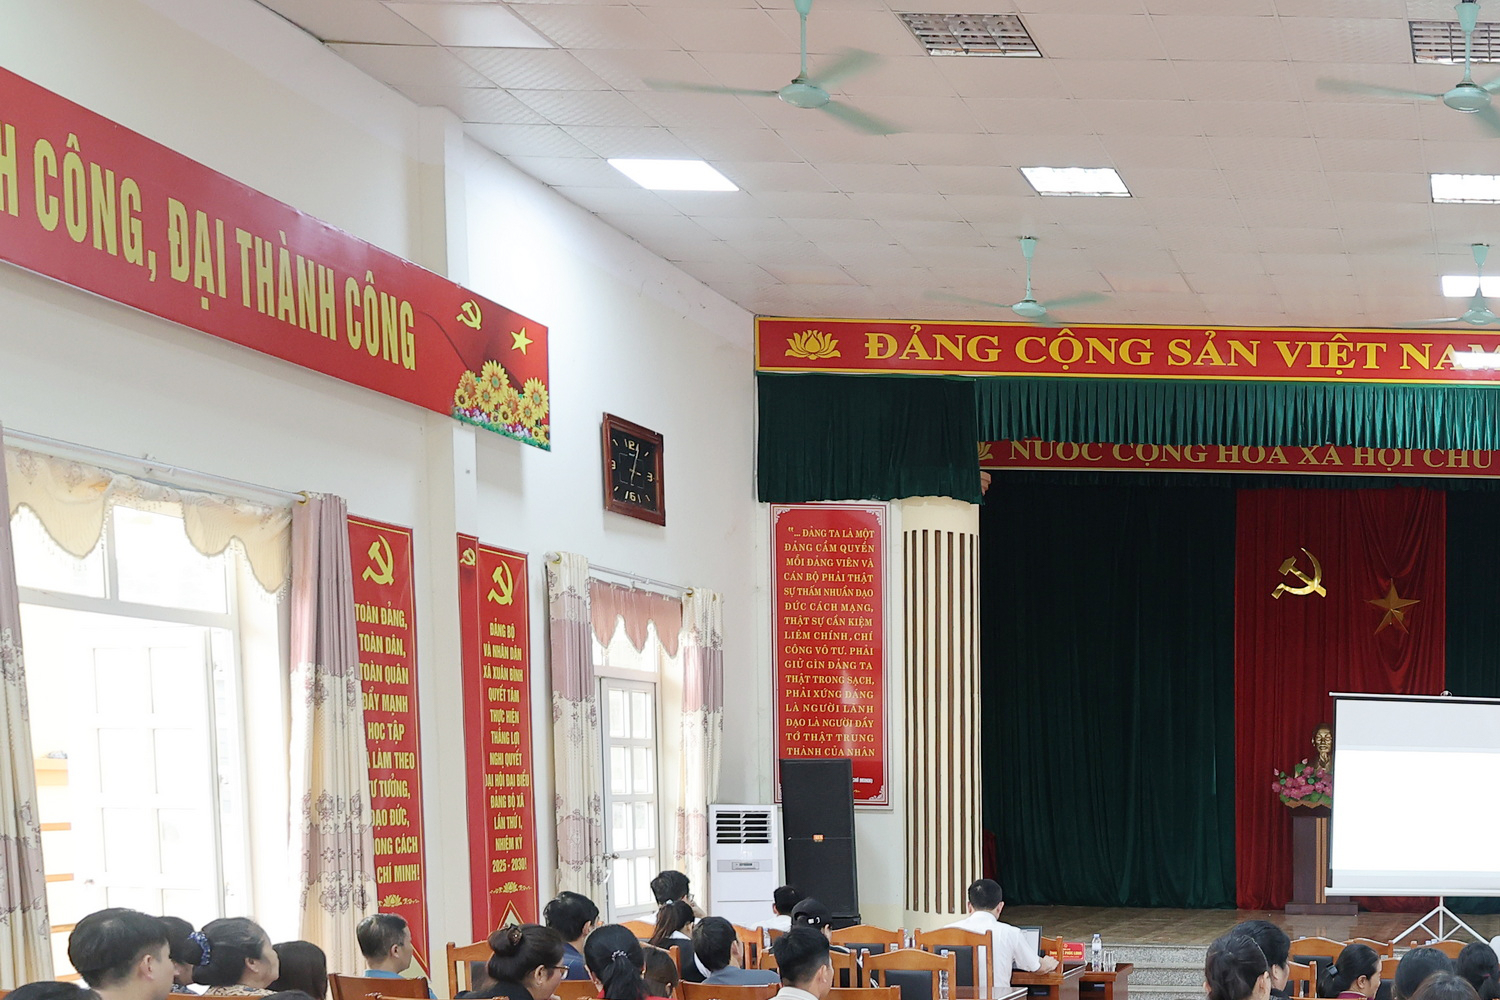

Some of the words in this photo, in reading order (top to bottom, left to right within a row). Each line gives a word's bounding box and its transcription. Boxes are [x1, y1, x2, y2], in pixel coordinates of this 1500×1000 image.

[33, 132, 157, 282] CÔNG,
[167, 197, 228, 310] ĐẠI
[235, 227, 338, 341] THÀNH
[344, 269, 417, 371] CÔNG
[863, 324, 1002, 363] ĐẢNG
[1014, 328, 1154, 370] CỘNG
[1166, 330, 1260, 368] SẢN
[1273, 334, 1387, 378] VIỆT
[367, 722, 386, 744] HỌC
[386, 720, 405, 745] TẬP
[835, 733, 874, 742] TRUNG
[372, 748, 392, 769] LÀM
[393, 751, 415, 769] THEO
[389, 804, 410, 828] ĐỨC,
[395, 833, 418, 854] CÁCH
[376, 862, 392, 884] CHÍ
[393, 863, 420, 882] MINH!
